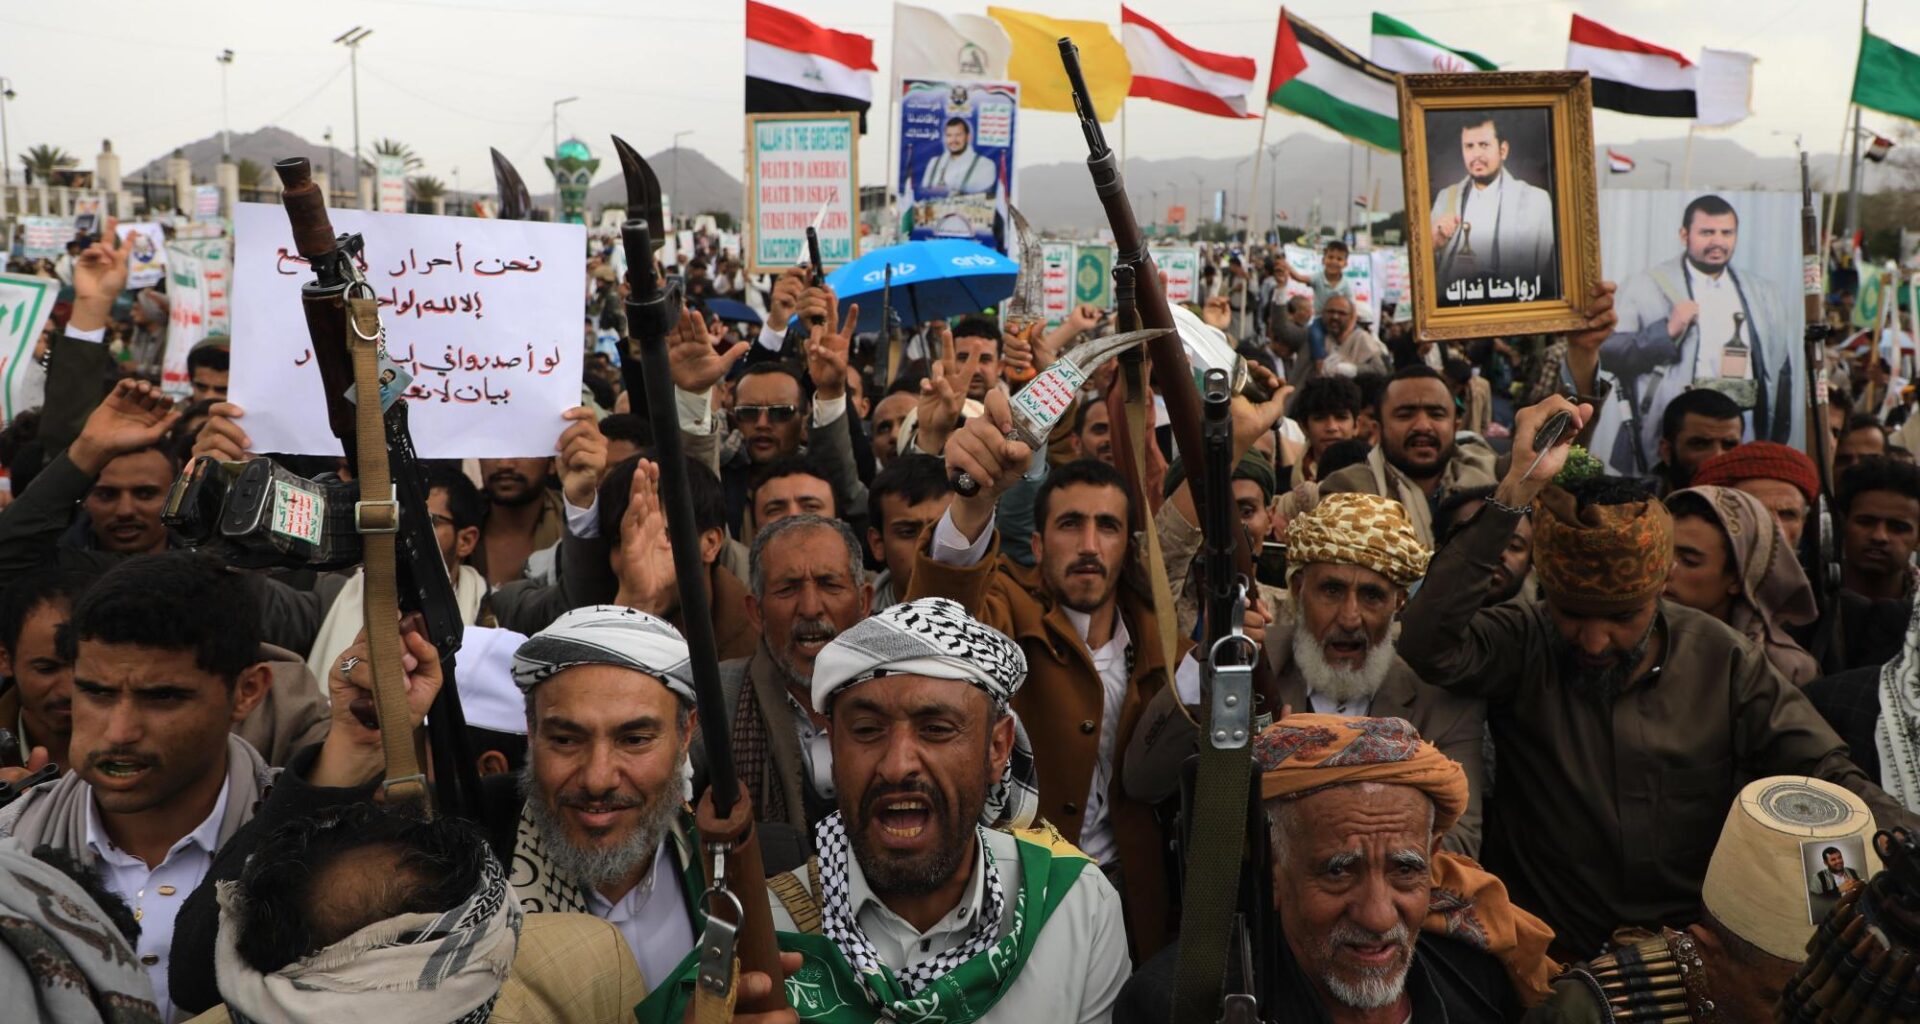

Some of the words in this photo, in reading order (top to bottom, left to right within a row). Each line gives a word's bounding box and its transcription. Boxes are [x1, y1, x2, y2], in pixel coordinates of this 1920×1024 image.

[762, 161, 790, 179] DEATH
[793, 161, 804, 179] TO
[807, 161, 848, 179] AMERICA
[762, 186, 790, 203] DEATH
[793, 186, 805, 203] TO
[389, 241, 464, 277] أحرار
[474, 254, 542, 277] نحن
[953, 254, 996, 266] anb
[1446, 278, 1484, 301] فداك
[376, 286, 422, 319] الواح
[538, 345, 561, 375] لو
[432, 379, 451, 402] لا
[453, 377, 511, 404] بيان
